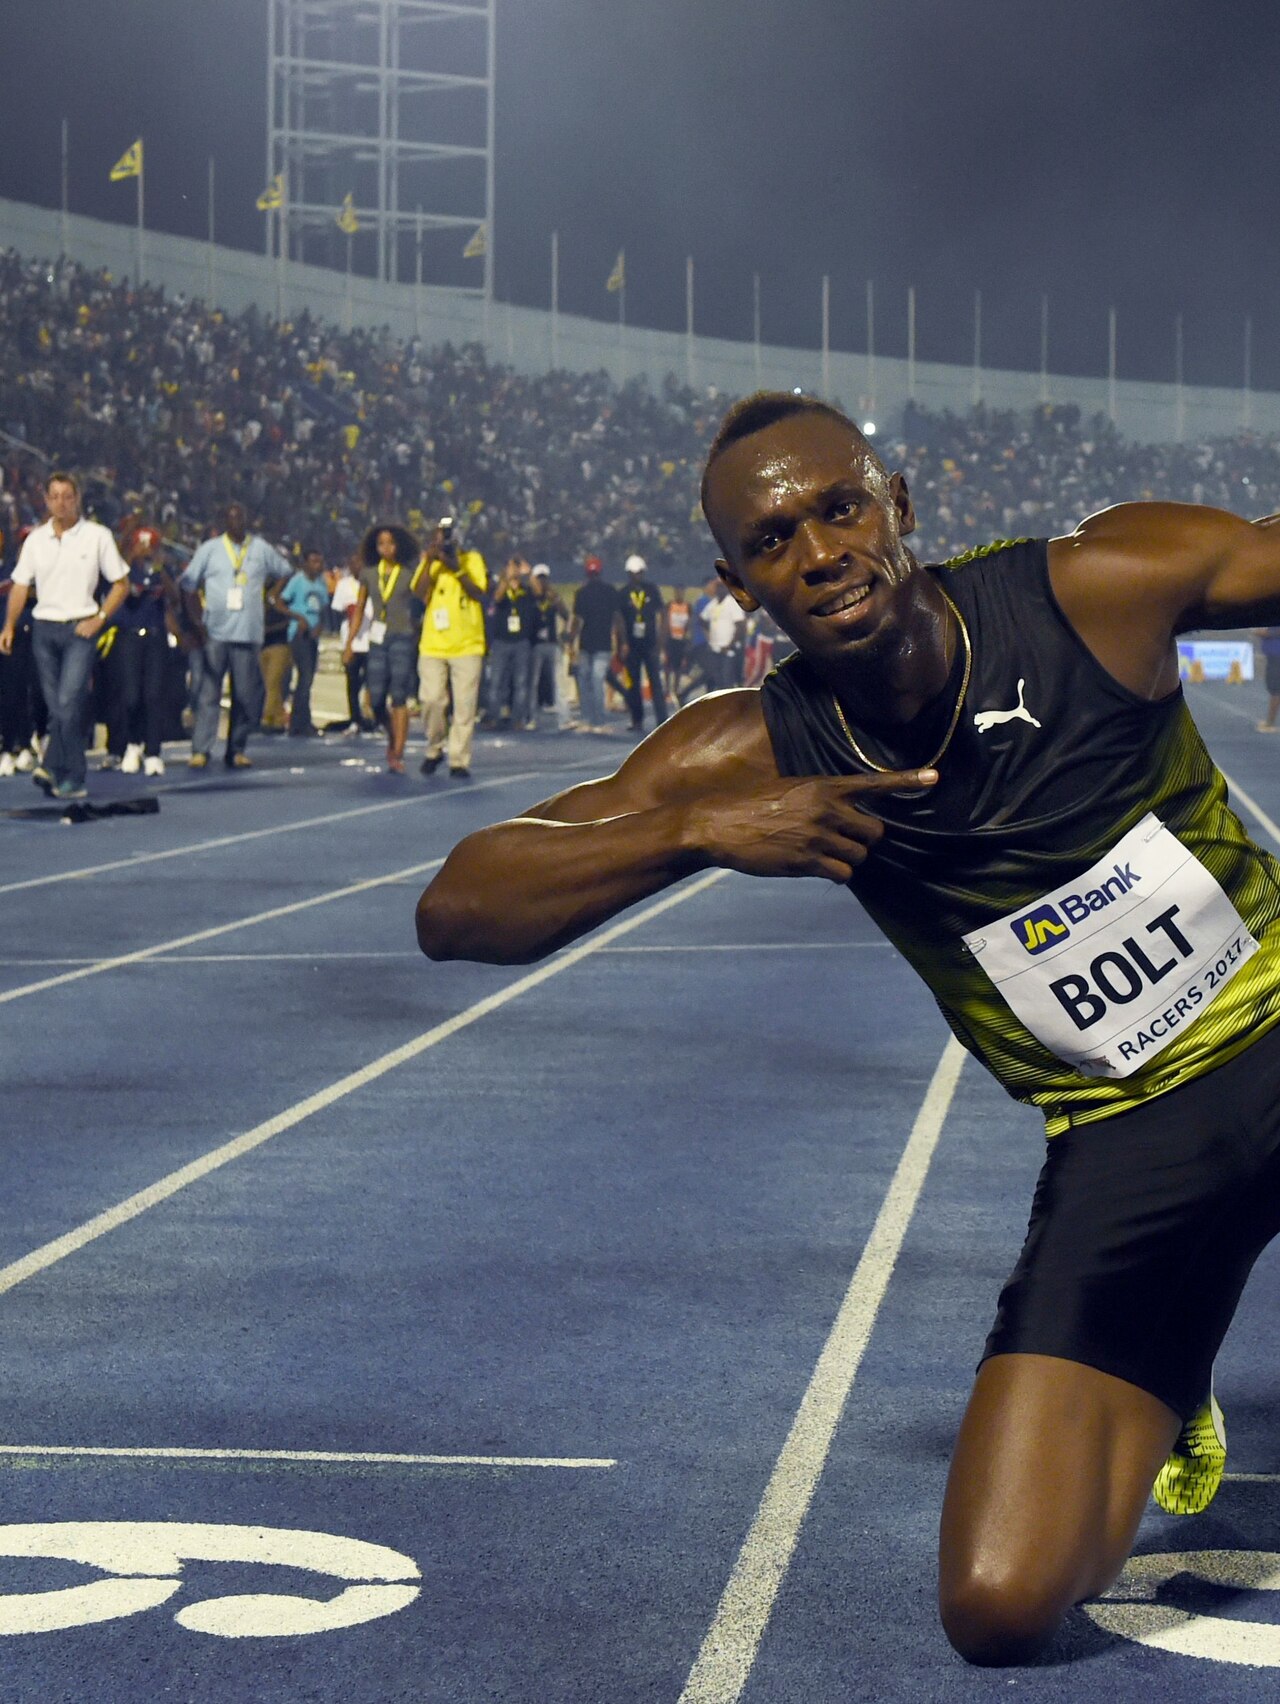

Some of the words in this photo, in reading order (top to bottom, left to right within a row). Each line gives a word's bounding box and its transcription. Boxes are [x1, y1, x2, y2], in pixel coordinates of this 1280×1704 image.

[1058, 862, 1142, 925] Bank
[1049, 904, 1194, 1031] BOLT
[1117, 986, 1203, 1060] RACERS
[1204, 937, 1243, 990] 2017
